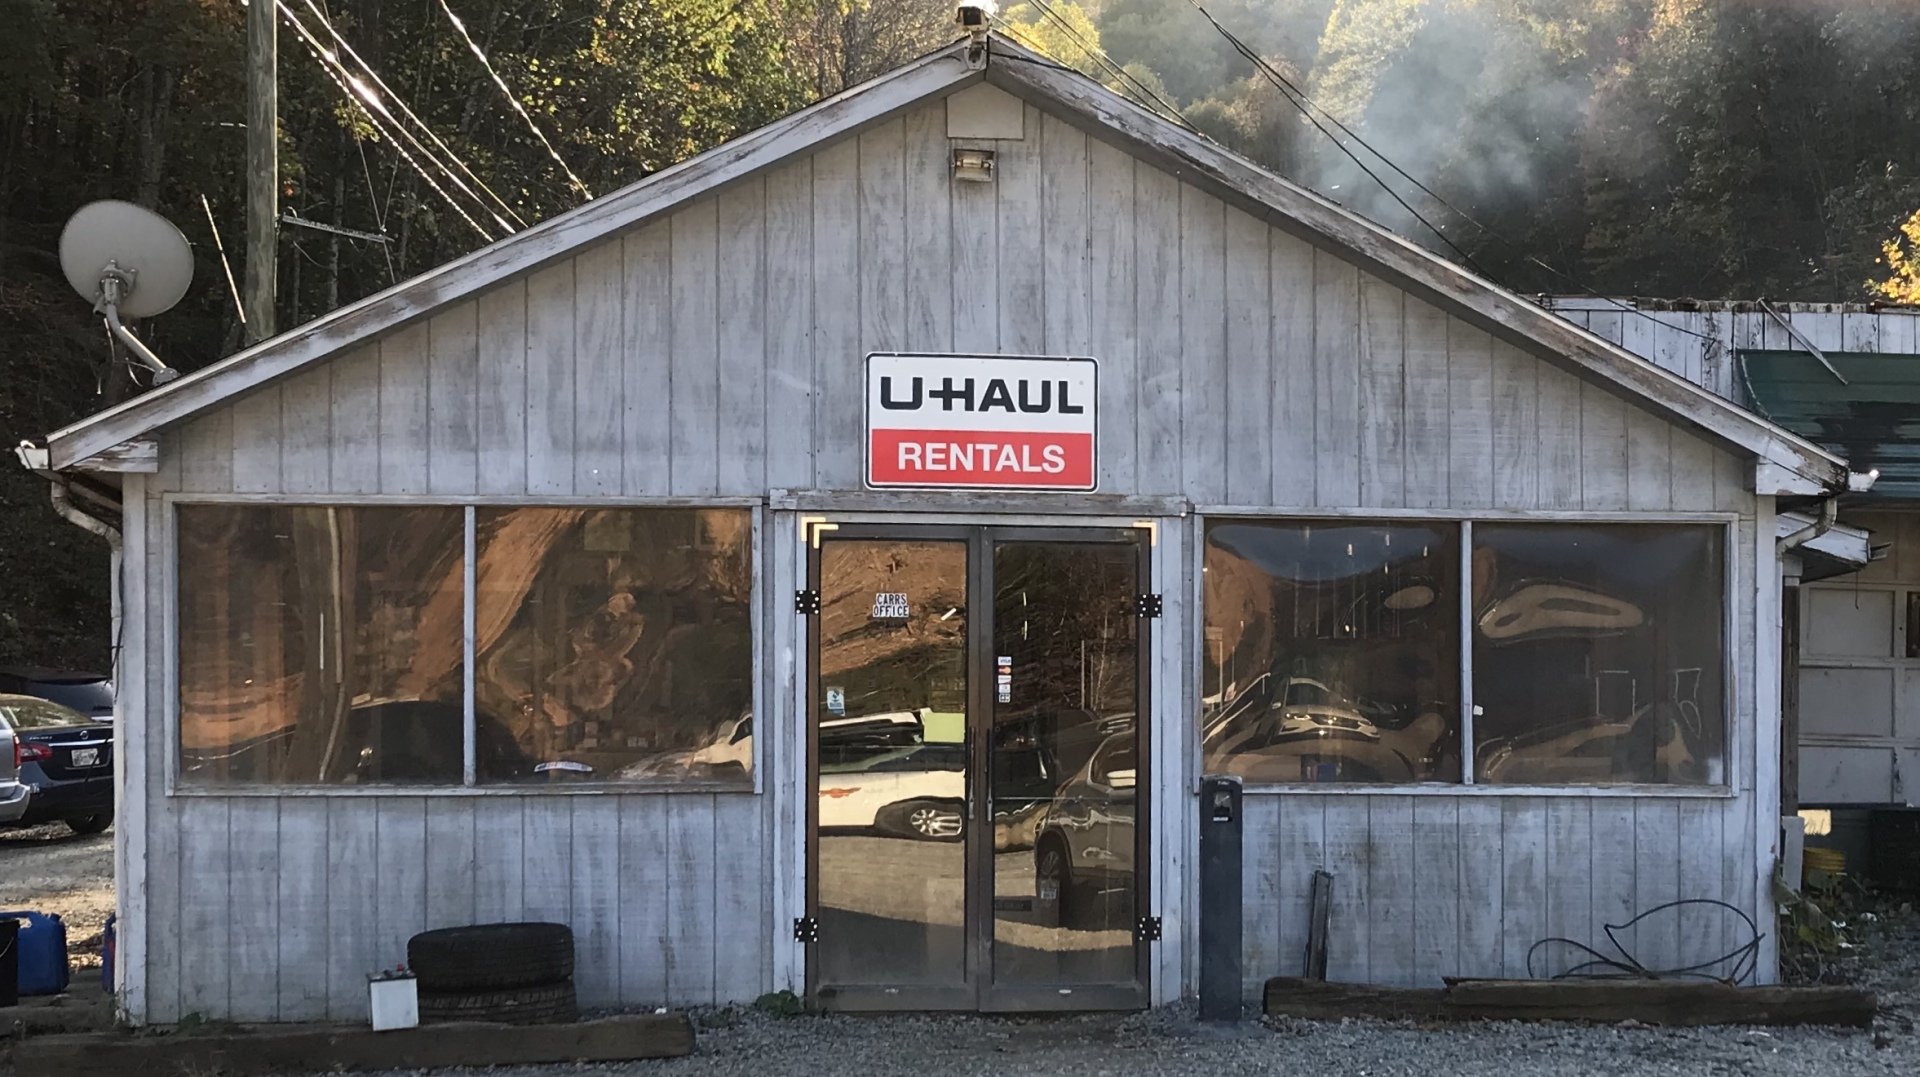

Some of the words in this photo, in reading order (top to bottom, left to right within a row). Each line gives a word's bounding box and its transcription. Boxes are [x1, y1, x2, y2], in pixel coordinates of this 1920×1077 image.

[880, 376, 1084, 414] U-HAUL
[898, 442, 1066, 473] RENTALS
[877, 594, 907, 605] CARRS
[873, 605, 909, 616] OFFICE
